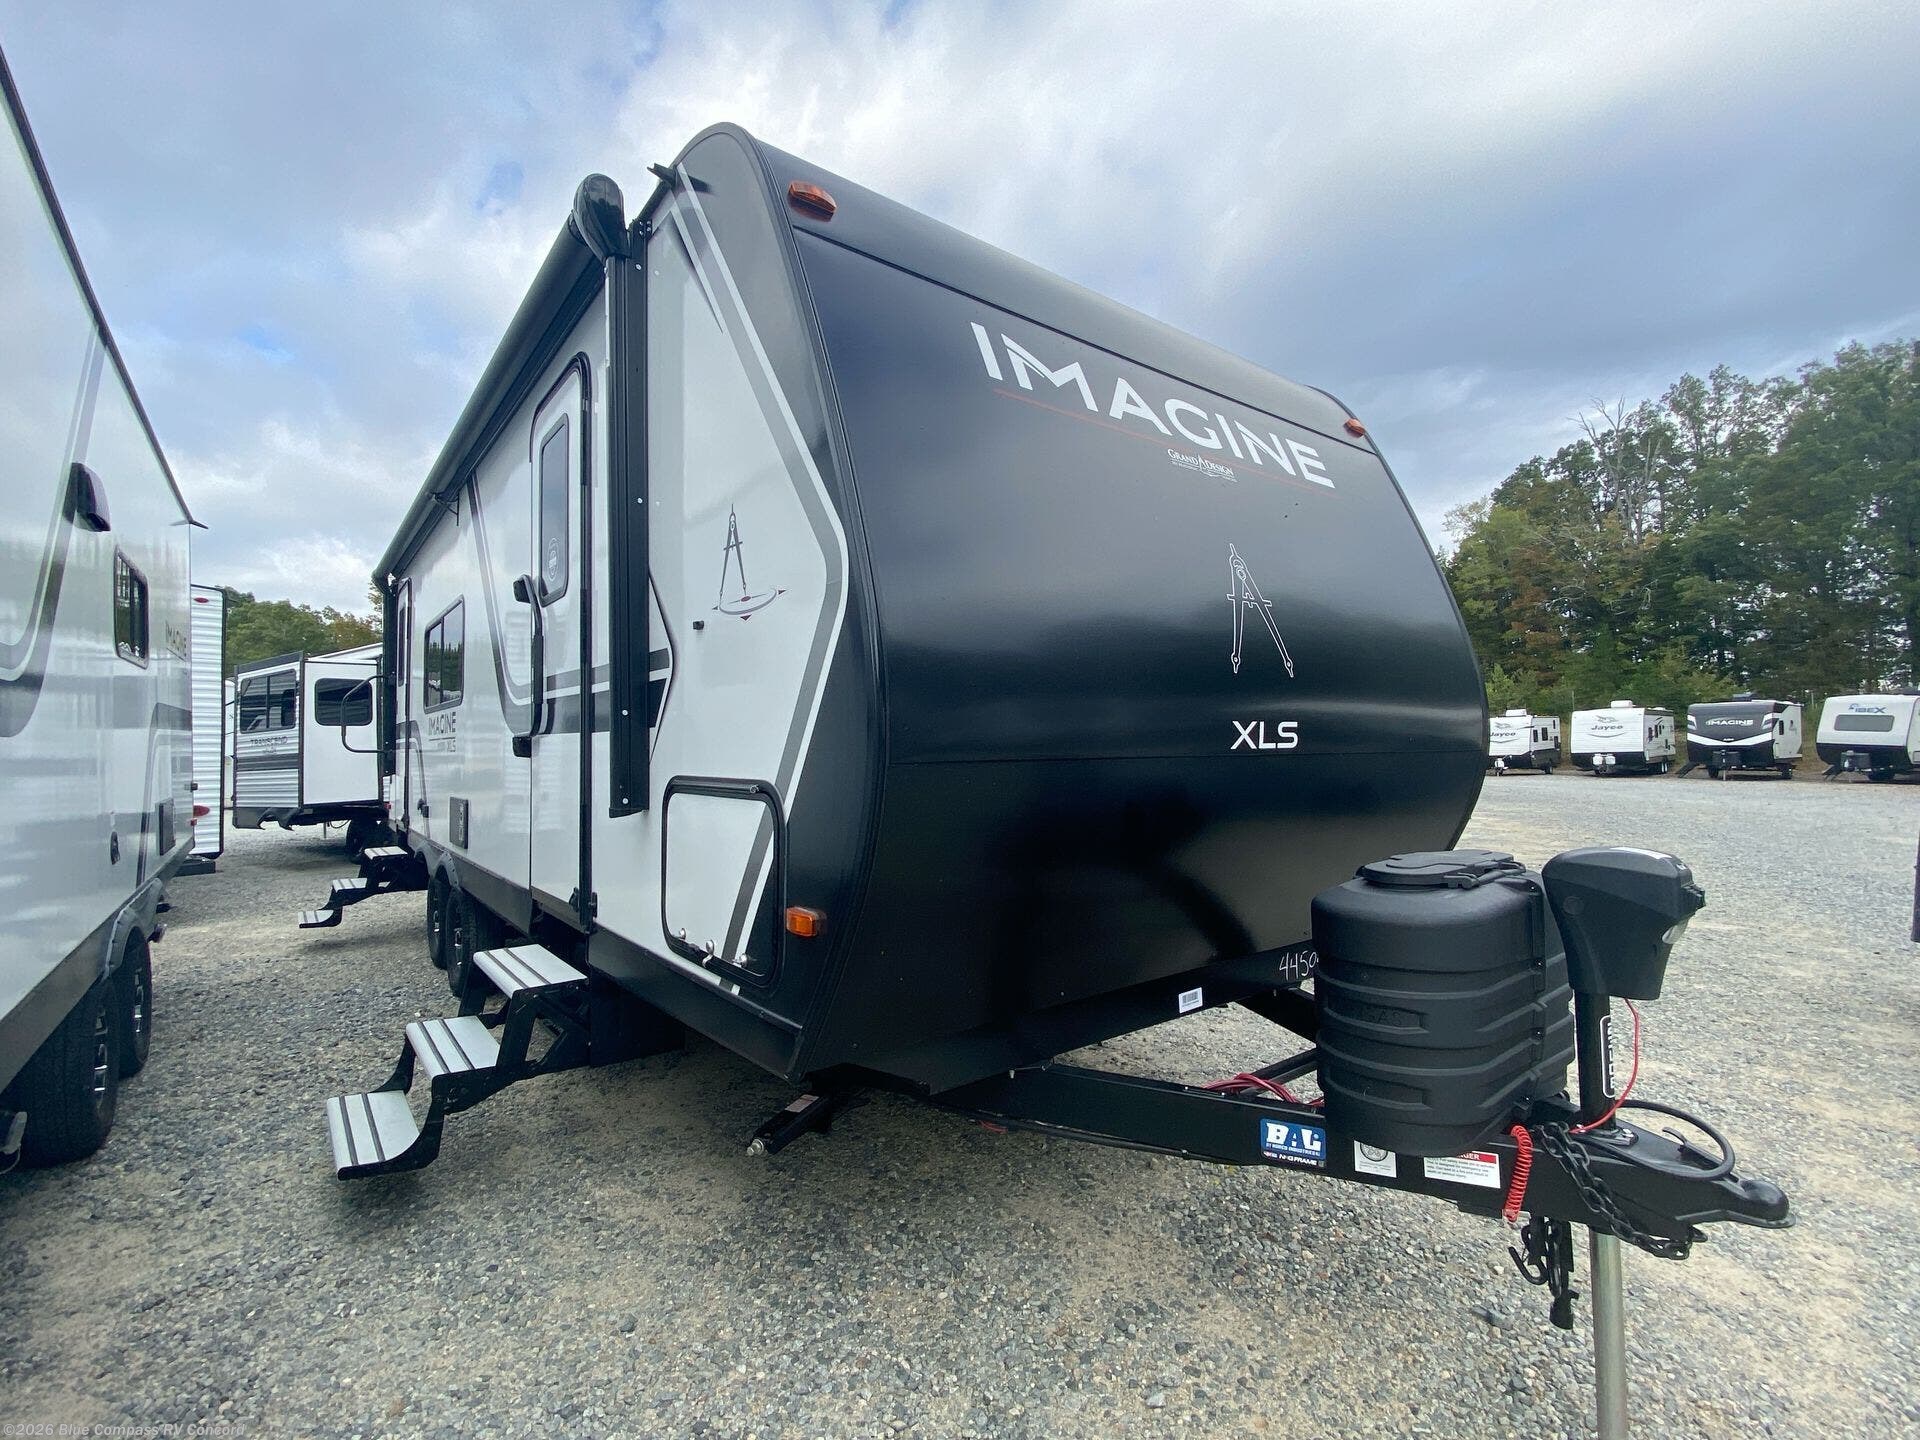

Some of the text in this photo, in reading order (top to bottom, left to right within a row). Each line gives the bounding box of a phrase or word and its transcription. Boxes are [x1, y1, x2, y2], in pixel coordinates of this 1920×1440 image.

[970, 321, 1335, 488] IMAGINE
[428, 711, 456, 736] IMAGINE
[1230, 720, 1299, 750] XLS
[1705, 719, 1754, 727] IMAGINE
[1266, 1122, 1322, 1152] BAL
